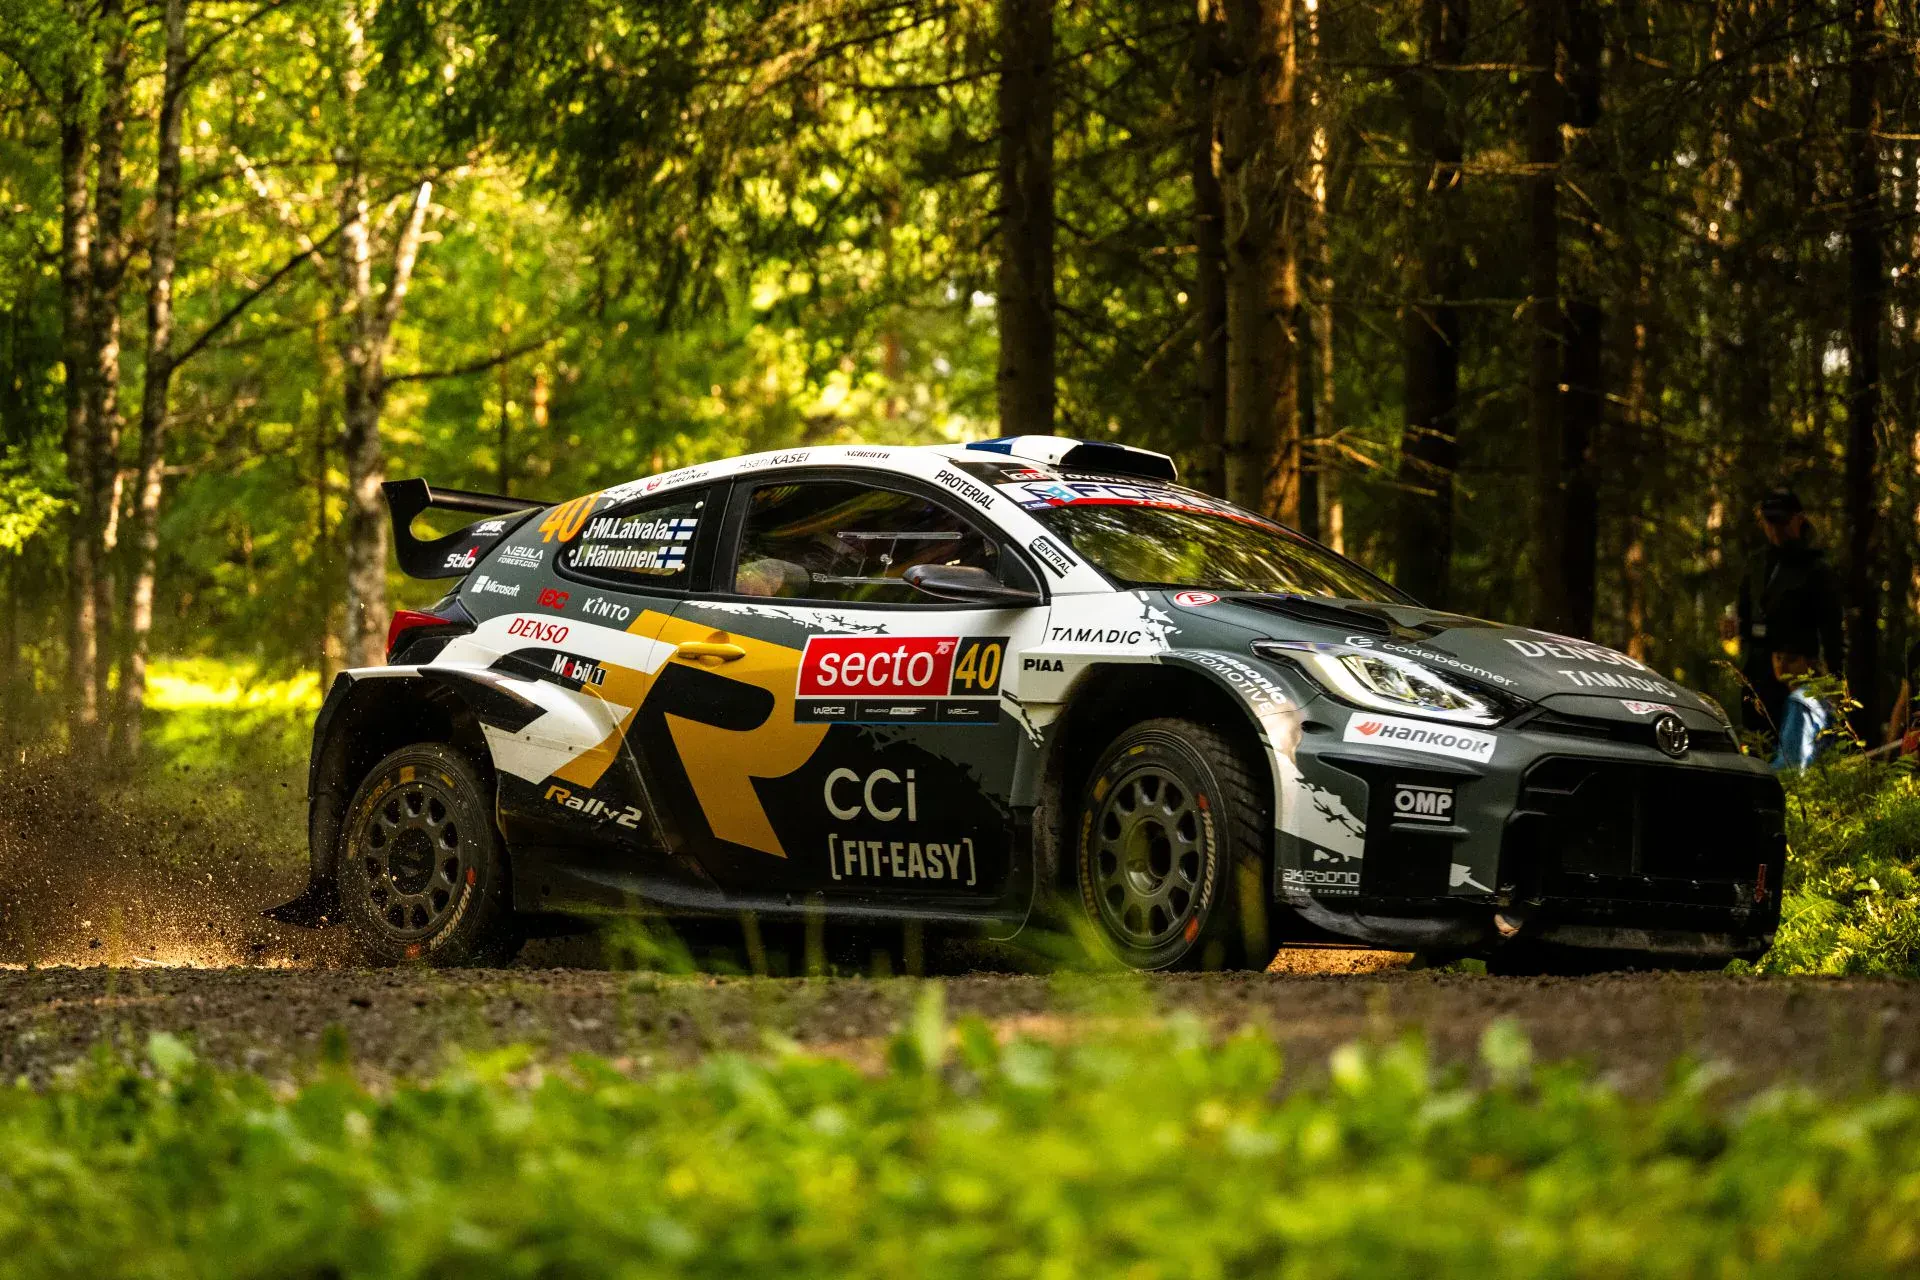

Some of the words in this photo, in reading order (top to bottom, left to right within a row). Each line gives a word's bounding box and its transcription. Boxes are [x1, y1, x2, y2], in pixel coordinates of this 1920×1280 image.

[665, 471, 709, 486] AIRLINES
[934, 469, 996, 511] PROTERIAL
[538, 491, 604, 543] 40
[570, 545, 658, 568] J.Hänninen
[1031, 537, 1072, 574] CENTRAL
[484, 580, 521, 596] Microsoft
[508, 618, 570, 643] DENSO
[1051, 627, 1142, 645] TAMADIC
[816, 645, 935, 687] secto
[955, 643, 1001, 690] 40
[1023, 658, 1065, 673] PIAA
[1383, 643, 1515, 687] codebeamer
[1503, 638, 1647, 671] DENSO
[552, 654, 592, 682] Mobil
[1557, 670, 1678, 698] TAMADIC
[813, 706, 846, 715] WRC2
[544, 785, 643, 829] Rally2
[1394, 790, 1453, 815] OMP
[1317, 888, 1361, 896] EXPERTS
